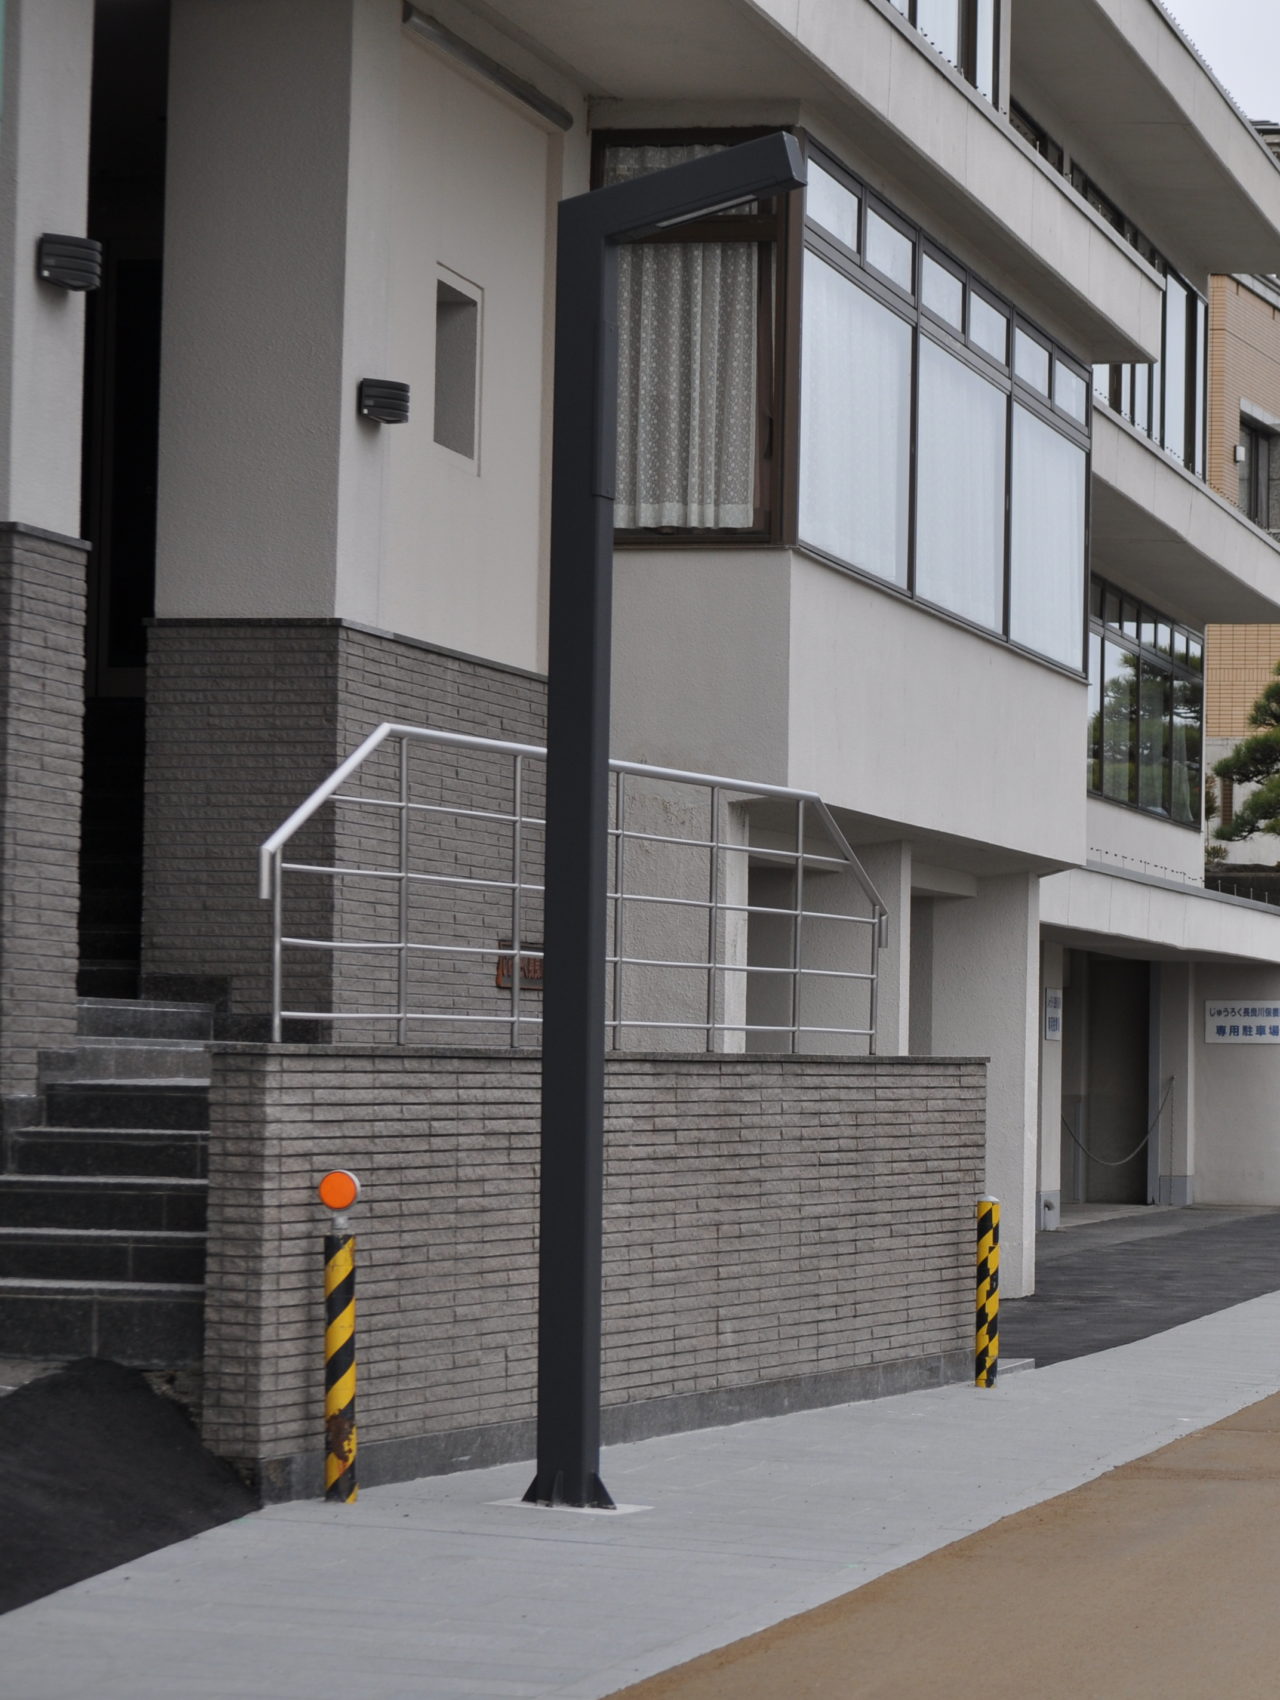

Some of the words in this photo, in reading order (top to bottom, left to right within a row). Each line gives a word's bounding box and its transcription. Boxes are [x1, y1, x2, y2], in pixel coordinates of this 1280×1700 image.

[1216, 1025, 1280, 1036] 専用駐車場
